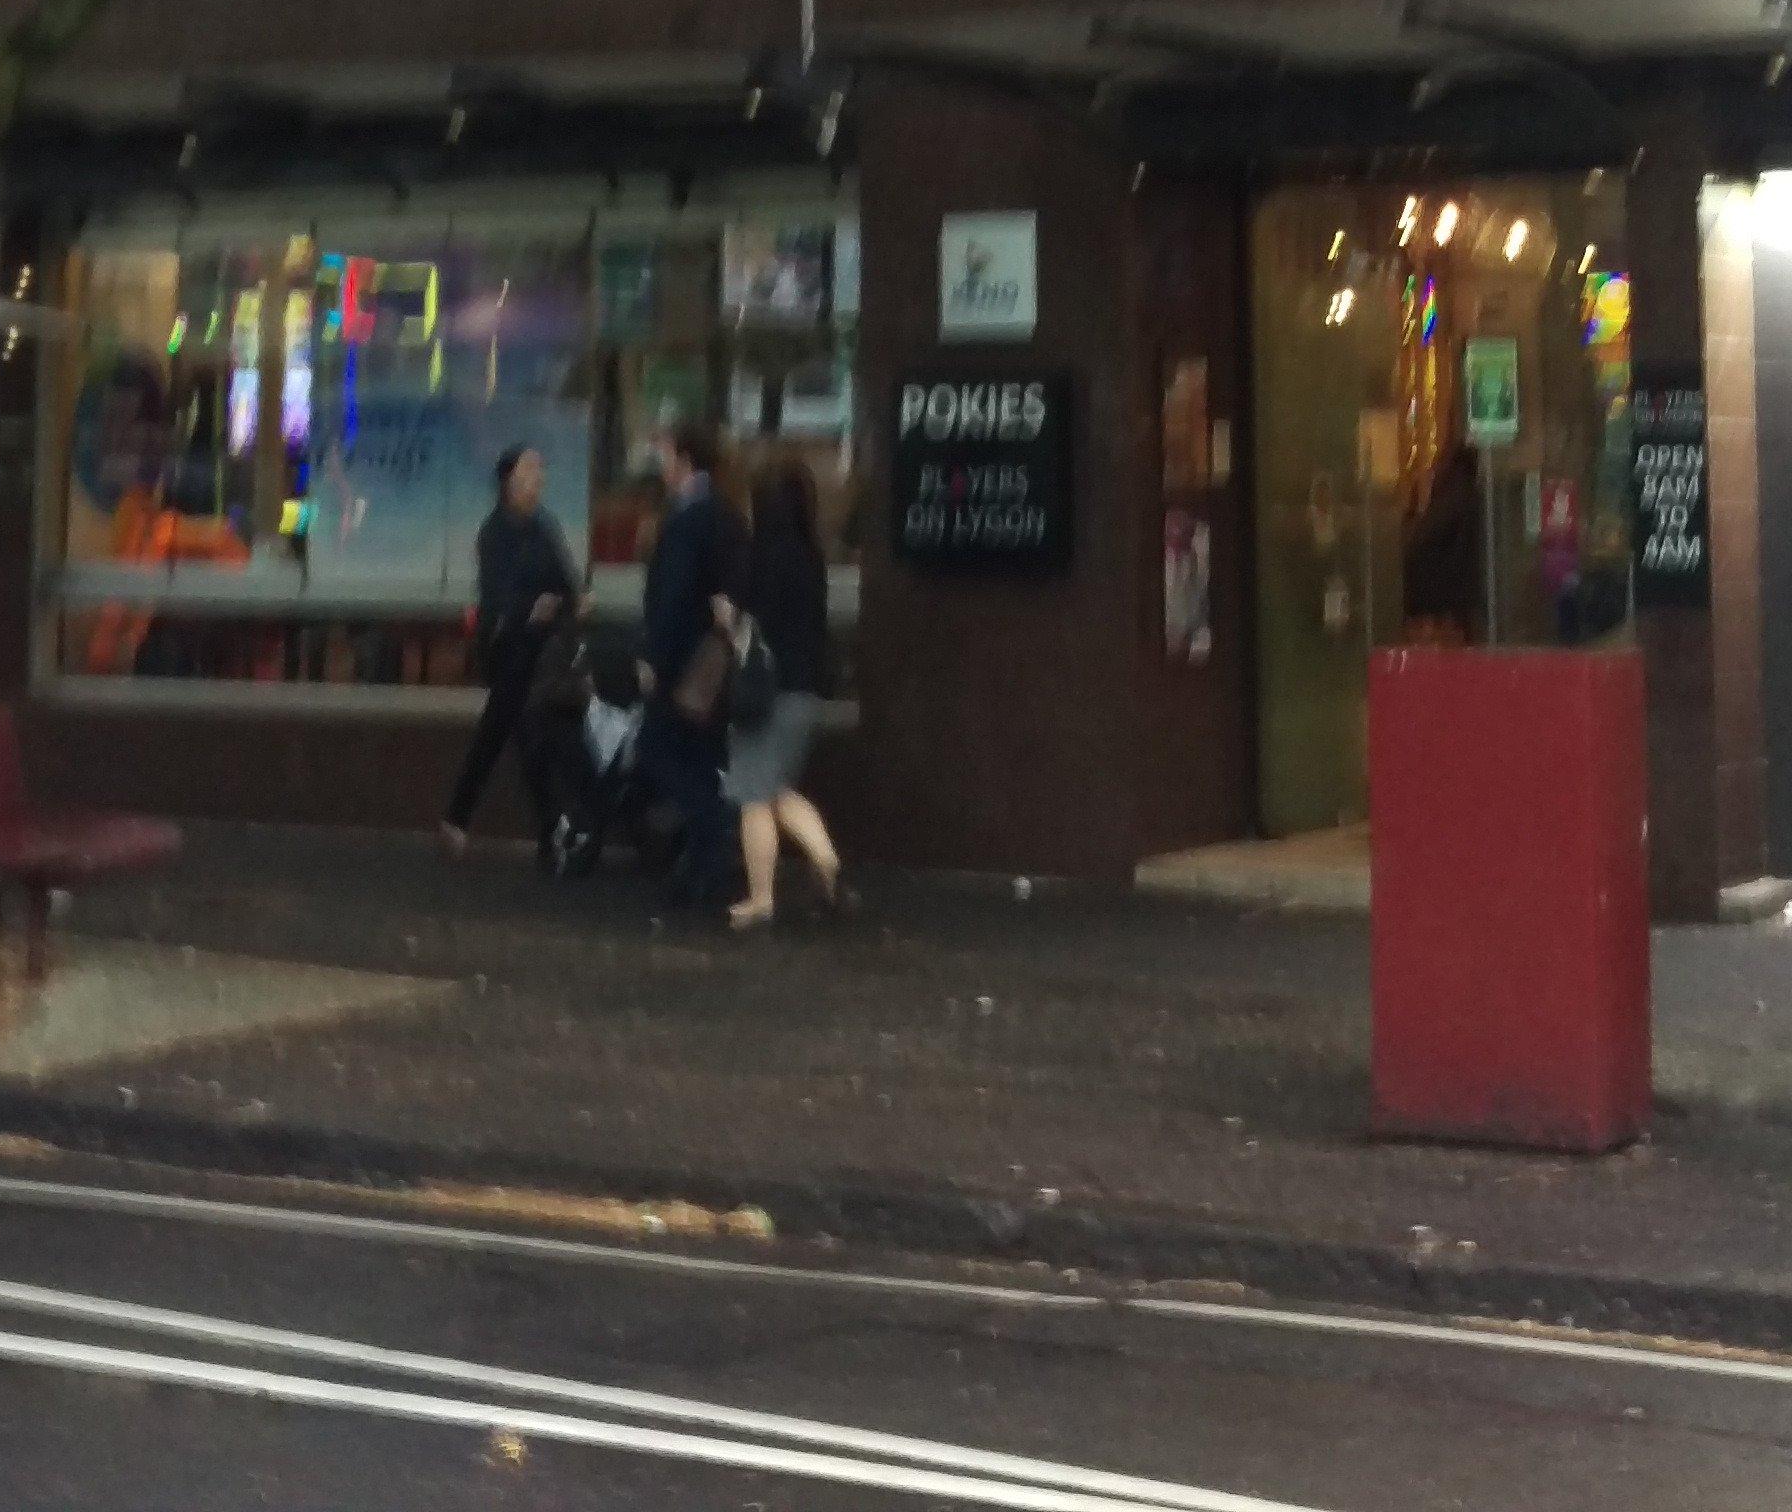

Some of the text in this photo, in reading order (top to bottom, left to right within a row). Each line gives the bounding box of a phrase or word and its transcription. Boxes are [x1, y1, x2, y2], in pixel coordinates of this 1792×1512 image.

[900, 382, 1046, 439] POKIES
[1635, 444, 1704, 475] OPEN
[953, 502, 1045, 545] LYGON
[1659, 504, 1688, 534] TO
